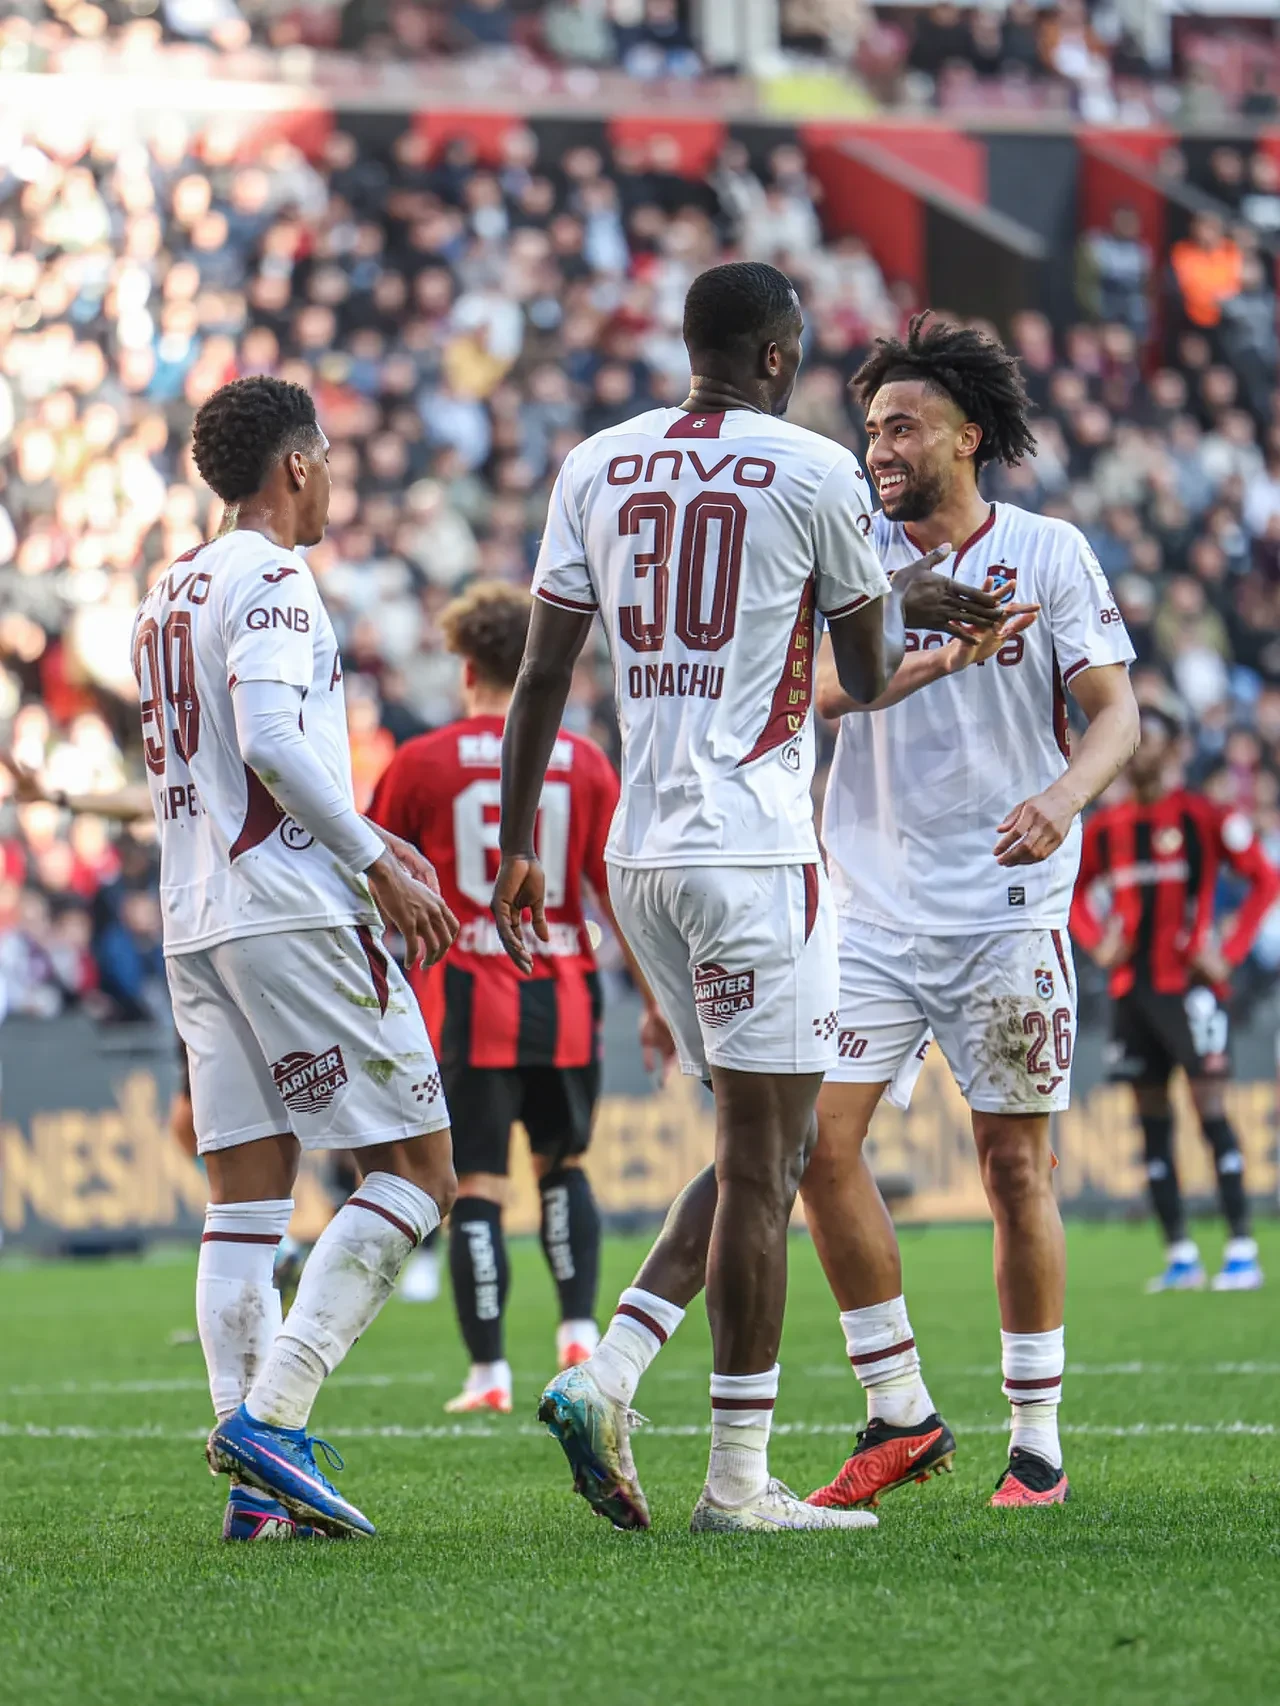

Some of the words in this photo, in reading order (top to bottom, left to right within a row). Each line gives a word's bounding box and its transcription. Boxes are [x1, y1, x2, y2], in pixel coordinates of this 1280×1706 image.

[618, 491, 748, 652] 30
[246, 606, 310, 633] QNB
[628, 663, 725, 700] ONACHU
[713, 997, 752, 1015] KOLA
[1022, 1007, 1072, 1074] 26
[276, 1052, 340, 1098] ARIYER
[311, 1073, 347, 1099] KOLA
